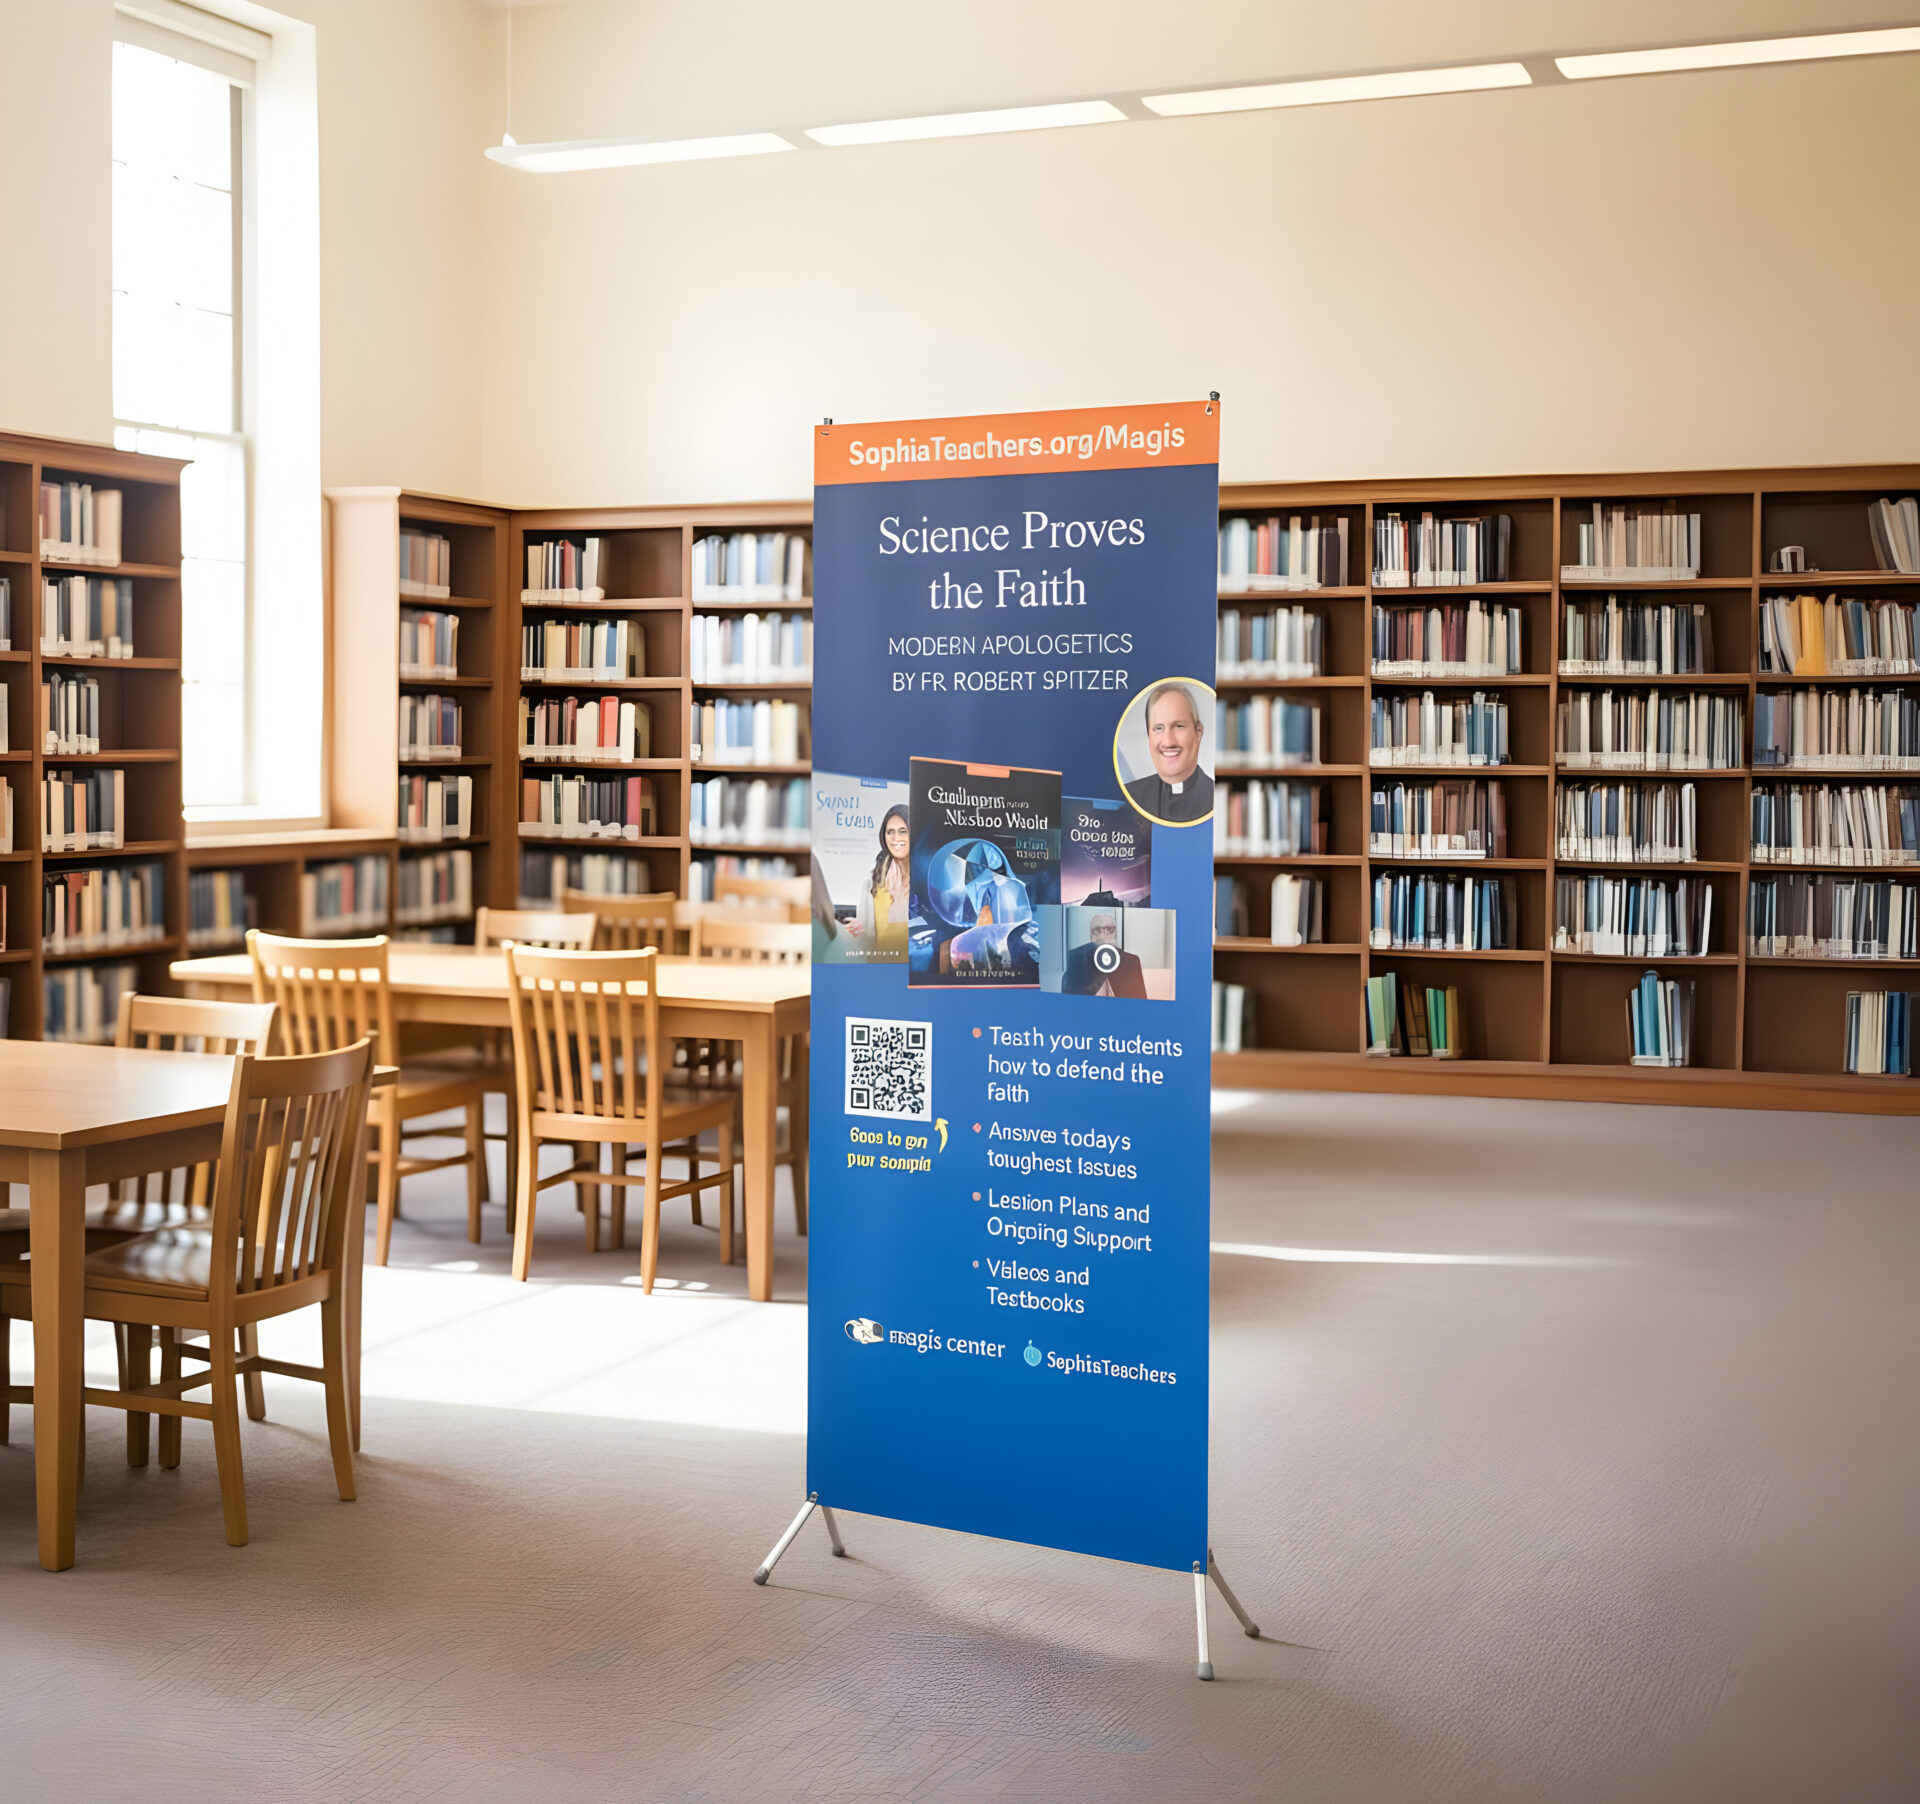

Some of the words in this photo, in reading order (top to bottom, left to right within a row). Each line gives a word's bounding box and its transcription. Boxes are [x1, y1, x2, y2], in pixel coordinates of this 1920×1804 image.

[879, 516, 1010, 555] Science
[1021, 511, 1146, 550] Proves
[929, 572, 983, 610] the
[994, 567, 1087, 609] Faith
[981, 633, 1133, 655] APOLOGETICS
[892, 673, 916, 692] BY
[921, 672, 947, 692] FR
[954, 671, 1036, 692] ROBERT
[1043, 669, 1129, 691] SPITZER
[1050, 1034, 1093, 1053] your
[1099, 1034, 1183, 1057] students
[988, 1053, 1027, 1075] how
[1031, 1058, 1050, 1077] to
[1056, 1057, 1125, 1081] defend
[1131, 1062, 1164, 1085] the
[1061, 1128, 1132, 1154] todays
[1059, 1195, 1109, 1219] Plans
[1114, 1204, 1150, 1224] and
[1055, 1266, 1090, 1286] and
[946, 1337, 1006, 1358] center
